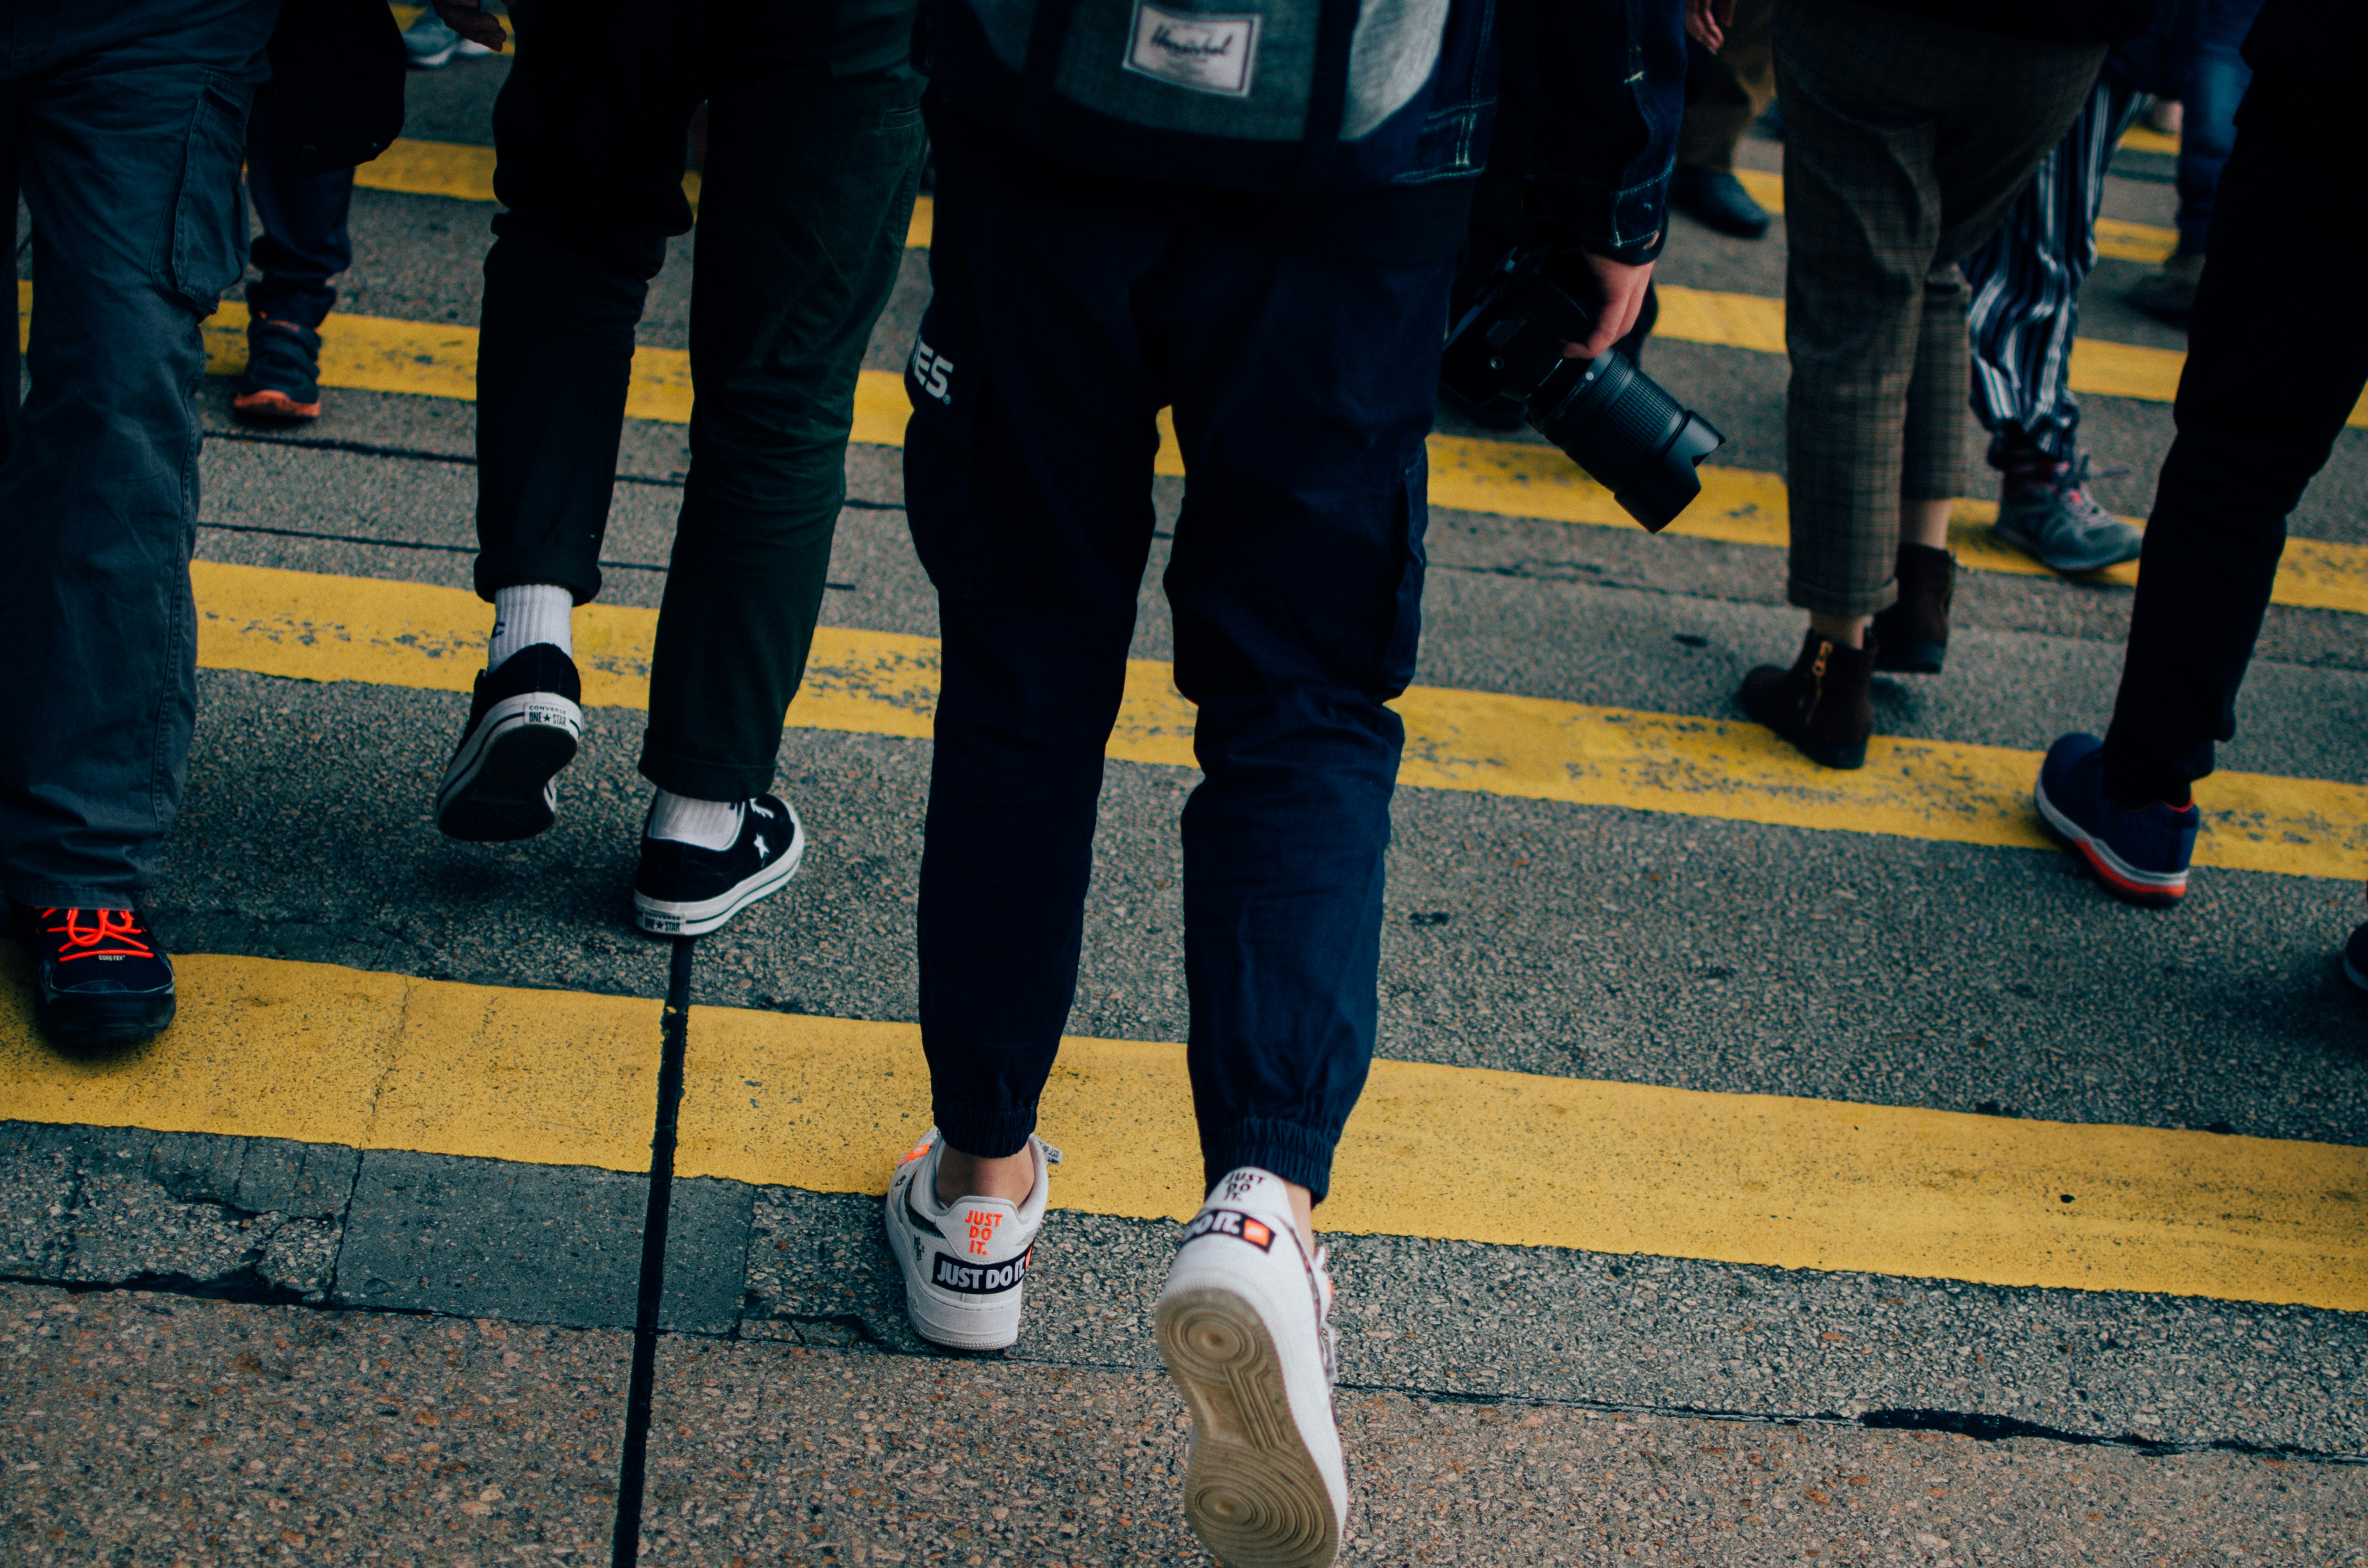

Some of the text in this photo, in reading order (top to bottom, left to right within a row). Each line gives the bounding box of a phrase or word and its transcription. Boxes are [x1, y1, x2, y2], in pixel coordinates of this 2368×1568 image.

[529, 705, 567, 715] CONVERSE
[529, 712, 567, 727] ONE STAR
[665, 921, 681, 932] STAR
[1226, 1171, 1266, 1185] JUST
[1227, 1183, 1251, 1192] DO
[965, 1209, 1003, 1227] JUST
[1212, 1211, 1242, 1235] IT.
[969, 1225, 992, 1241] DO
[969, 1240, 989, 1255] IT.
[937, 1260, 984, 1289] JUST
[985, 1265, 1013, 1289] DO
